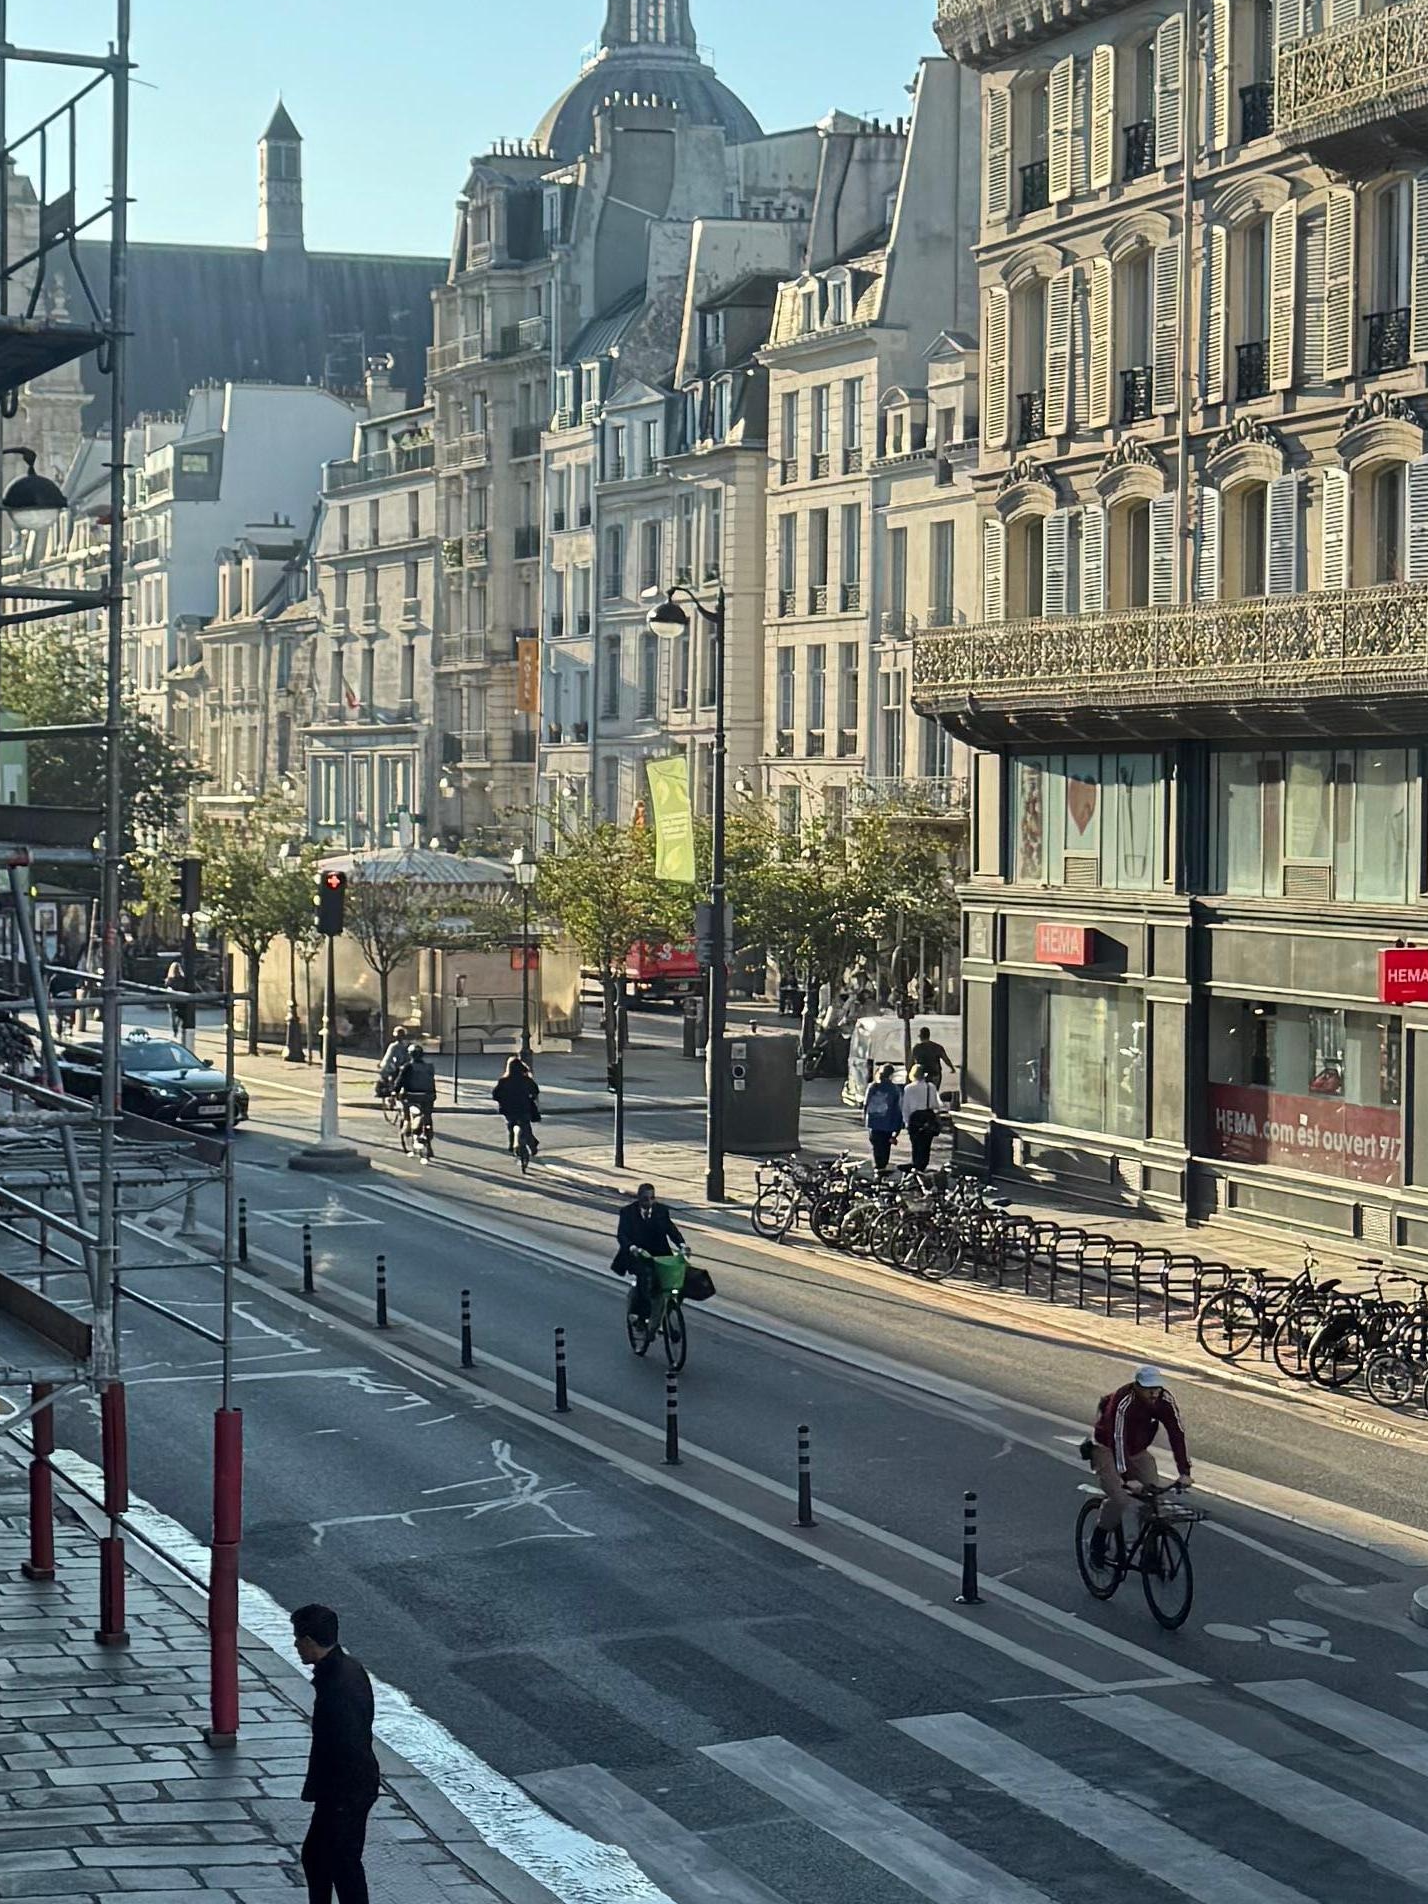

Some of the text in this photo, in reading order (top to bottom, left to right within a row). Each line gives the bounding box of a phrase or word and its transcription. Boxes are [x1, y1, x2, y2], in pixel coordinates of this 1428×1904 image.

[1043, 926, 1079, 954] HEMA
[1297, 1122, 1320, 1148] est
[1322, 1129, 1376, 1159] ouvert
